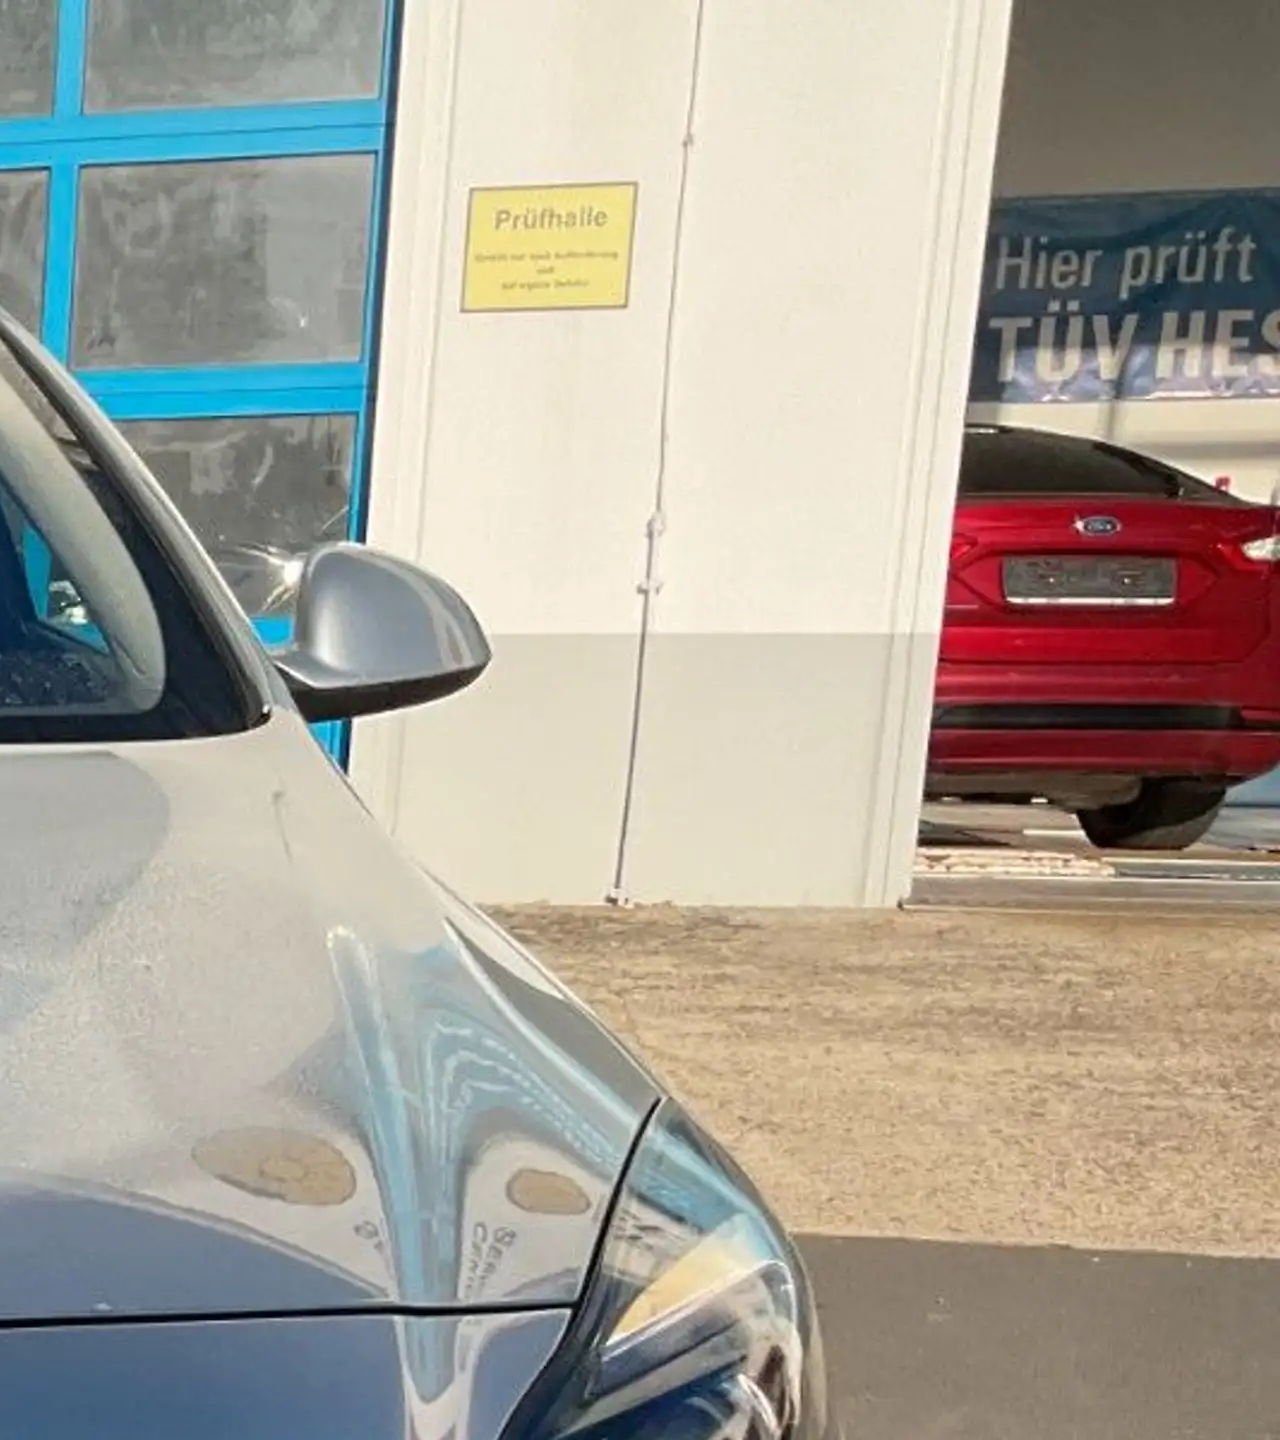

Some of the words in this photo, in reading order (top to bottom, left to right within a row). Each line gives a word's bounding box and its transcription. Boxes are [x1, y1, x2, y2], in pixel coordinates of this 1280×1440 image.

[495, 204, 608, 231] Prüfhalle
[996, 236, 1103, 291] Hier
[1119, 224, 1257, 300] prüft
[989, 300, 1138, 383] TÜV
